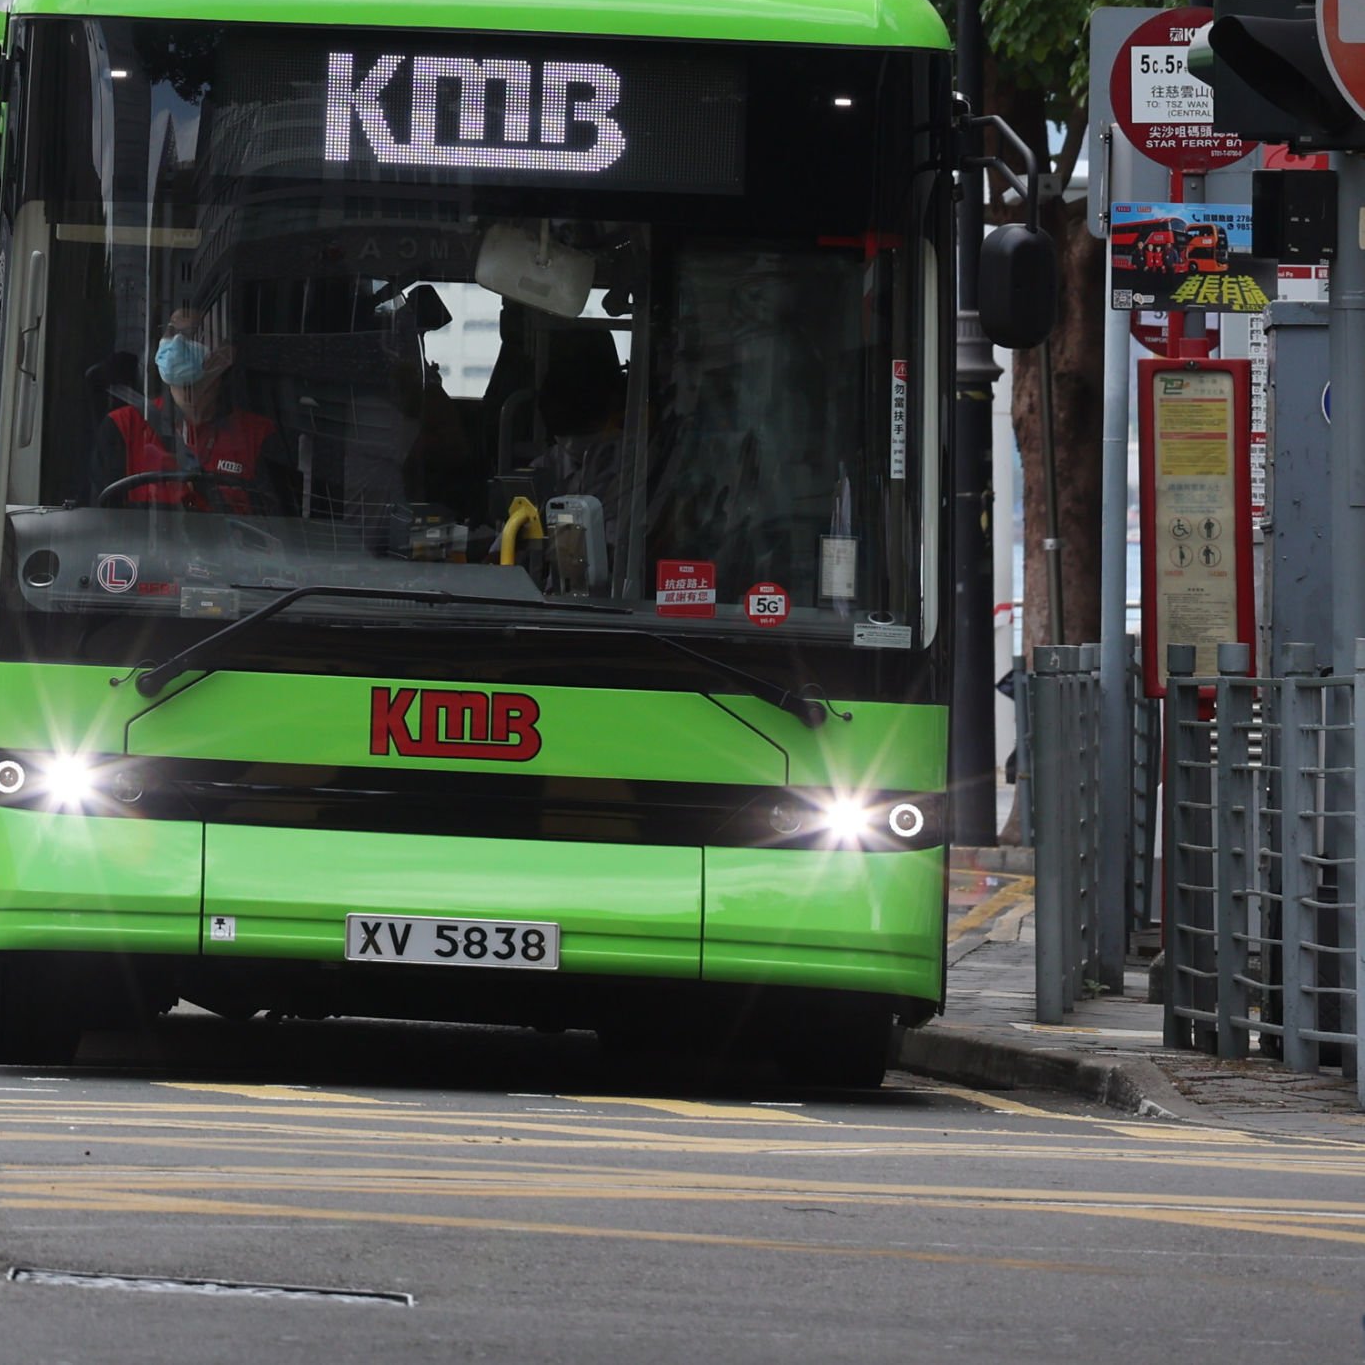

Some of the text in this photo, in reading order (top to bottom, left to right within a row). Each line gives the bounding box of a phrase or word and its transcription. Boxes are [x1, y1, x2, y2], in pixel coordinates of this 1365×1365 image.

[324, 51, 627, 173] KMB
[1150, 125, 1238, 138] 尖沙咀碼頭
[1146, 139, 1176, 147] STAR
[1182, 139, 1219, 147] FERRY
[665, 578, 708, 589] 抗疫路上
[756, 598, 779, 613] 5G
[369, 686, 542, 762] KMB
[360, 921, 547, 962] XV 5838
